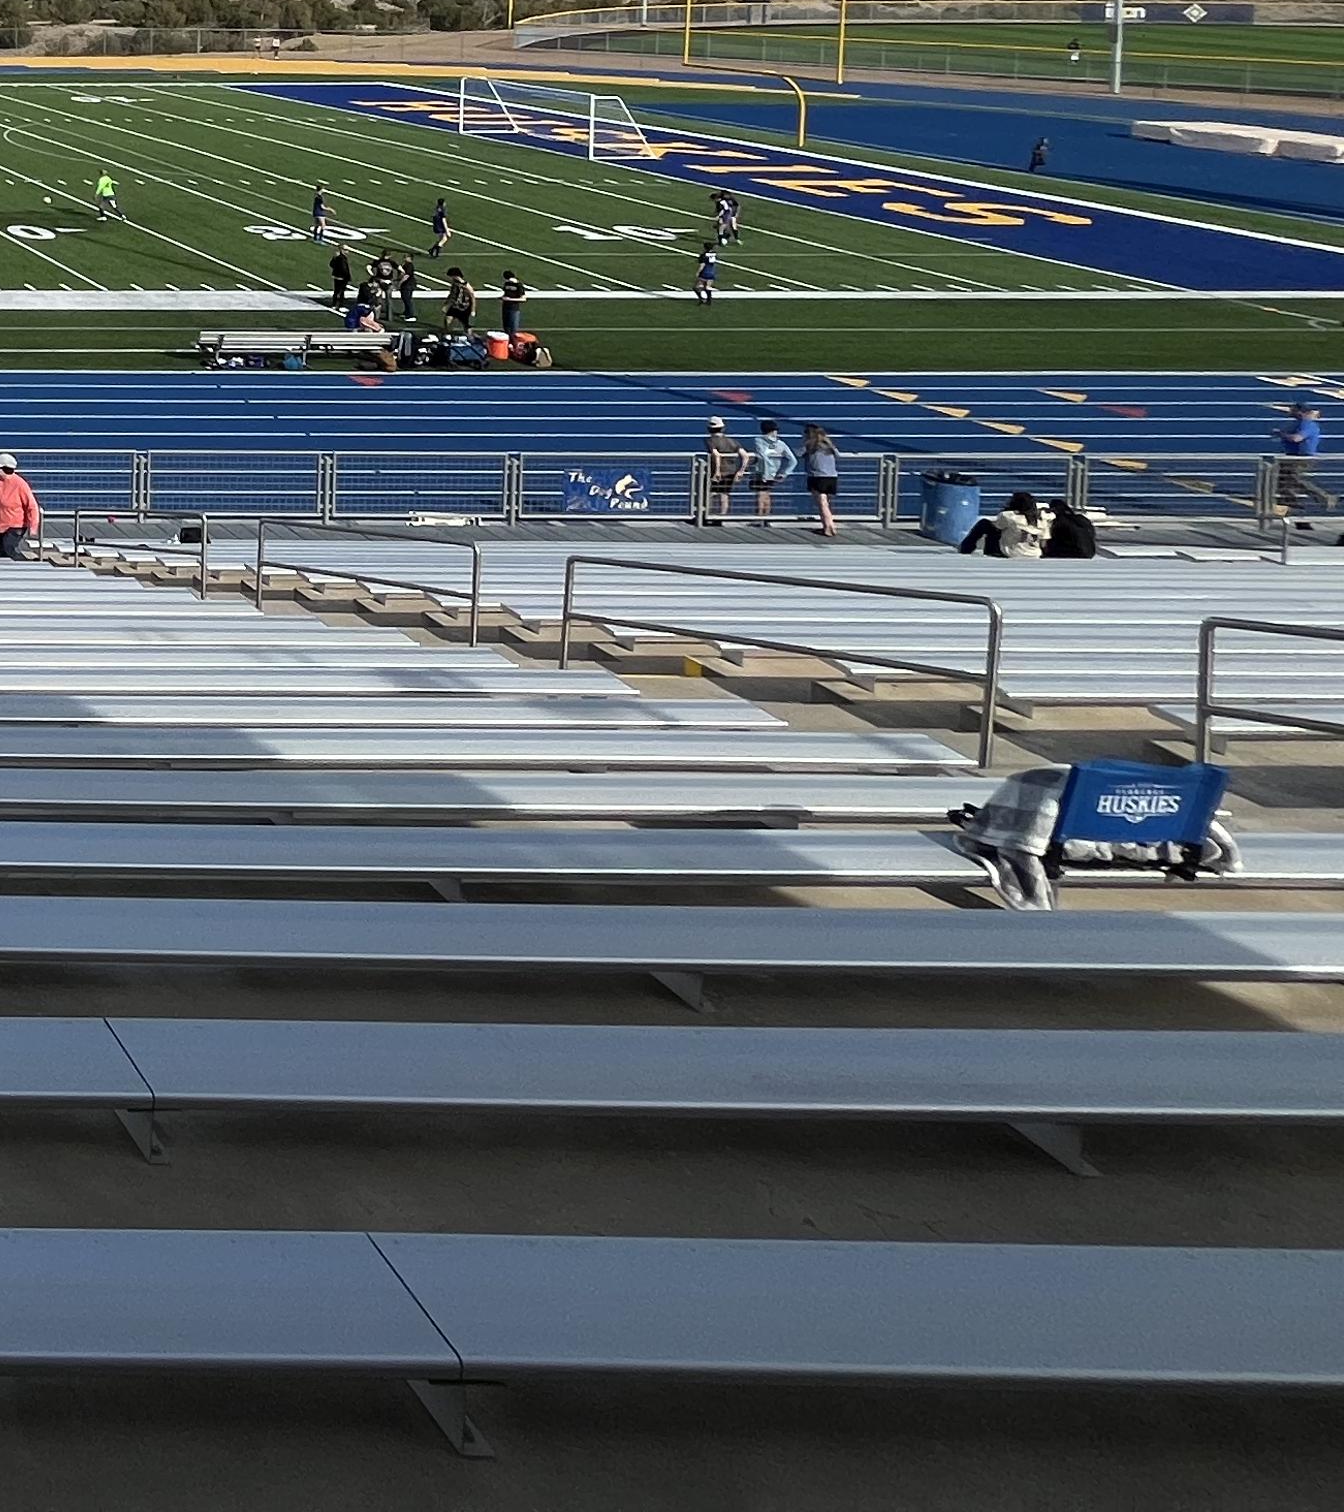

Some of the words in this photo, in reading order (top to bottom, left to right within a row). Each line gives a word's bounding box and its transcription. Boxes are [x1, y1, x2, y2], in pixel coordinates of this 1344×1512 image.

[552, 225, 678, 241] 10
[568, 471, 593, 484] The
[609, 497, 649, 510] Pound
[1096, 794, 1182, 814] HUSKIES
